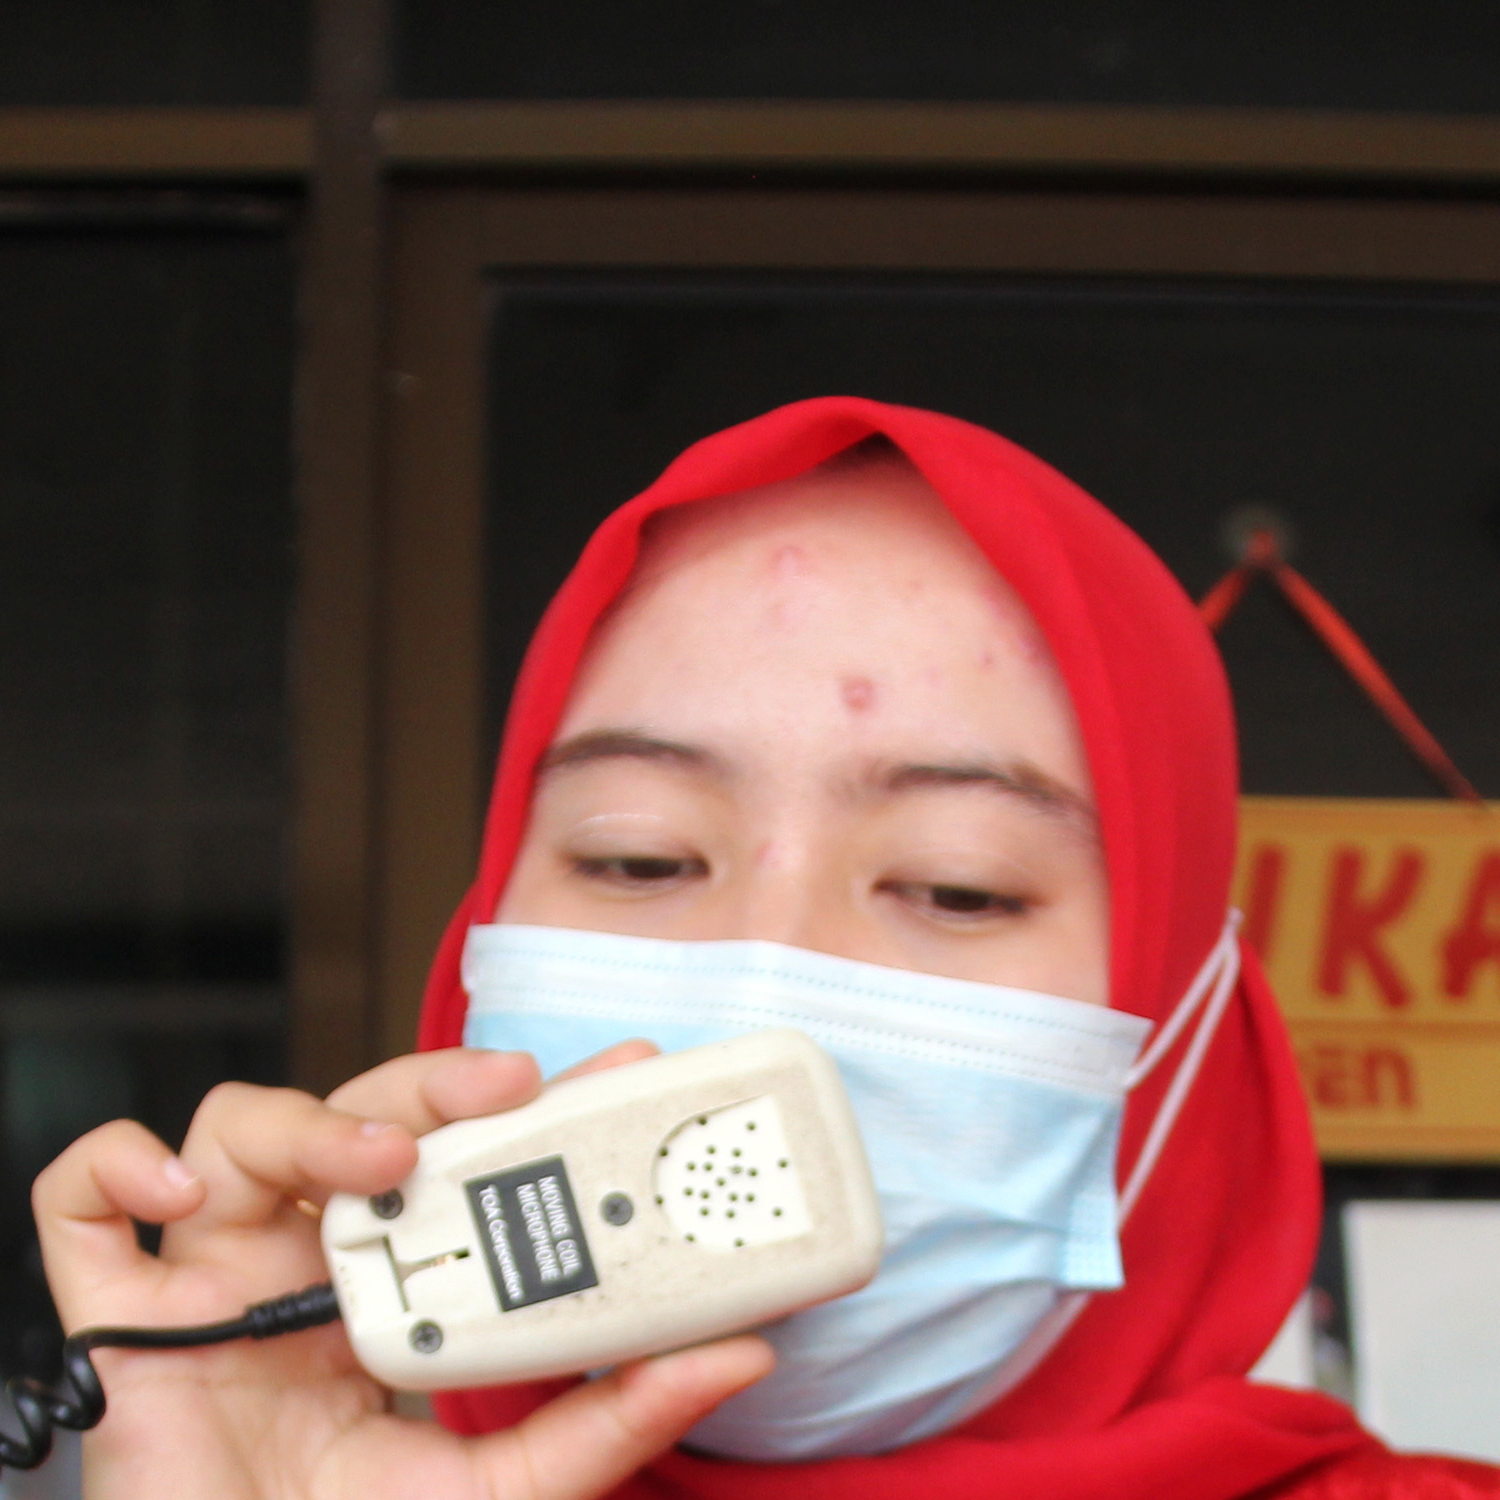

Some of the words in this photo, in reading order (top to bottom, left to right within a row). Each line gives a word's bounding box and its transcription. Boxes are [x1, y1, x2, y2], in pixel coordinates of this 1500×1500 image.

[479, 1184, 504, 1221] TOA
[516, 1182, 563, 1284] MICROPHONE
[537, 1175, 573, 1240] MOVING
[555, 1239, 583, 1280] COIL
[488, 1219, 525, 1303] Corporation
